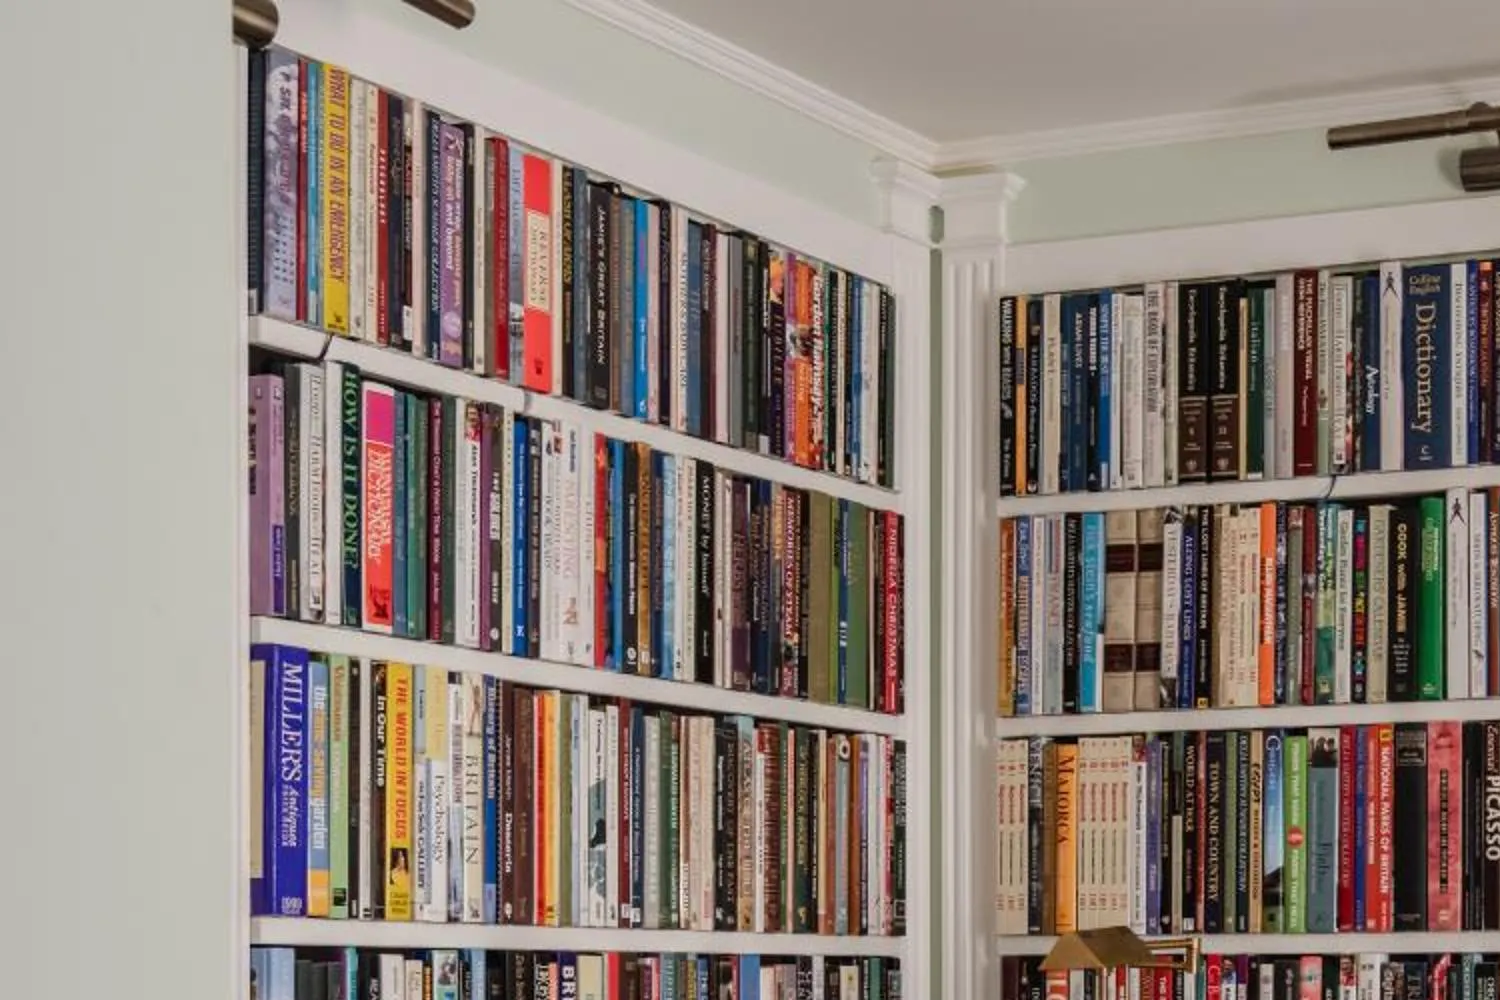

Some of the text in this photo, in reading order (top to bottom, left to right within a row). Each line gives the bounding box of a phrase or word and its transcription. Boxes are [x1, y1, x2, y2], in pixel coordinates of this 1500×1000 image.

[329, 68, 345, 107] WHAT
[329, 113, 345, 128] TO
[329, 131, 345, 152] DO
[329, 156, 345, 170] IN
[329, 176, 345, 197] AN
[597, 309, 606, 364] BRITAIN
[1002, 300, 1011, 344] WALKING
[1411, 302, 1436, 433] Dictionary
[344, 372, 357, 569] HOW IS IT DONE?
[701, 475, 711, 532] MONET
[1397, 524, 1406, 560] COOK
[1397, 564, 1406, 590] with
[282, 662, 302, 781] MILLER'S
[395, 678, 407, 839] THE WORLD IN FOCUS
[1380, 747, 1390, 799] NATIONAL
[466, 755, 480, 865] BRITAIN
[1208, 762, 1219, 902] TOWN AND COUNTRY
[1380, 802, 1390, 835] PARKS
